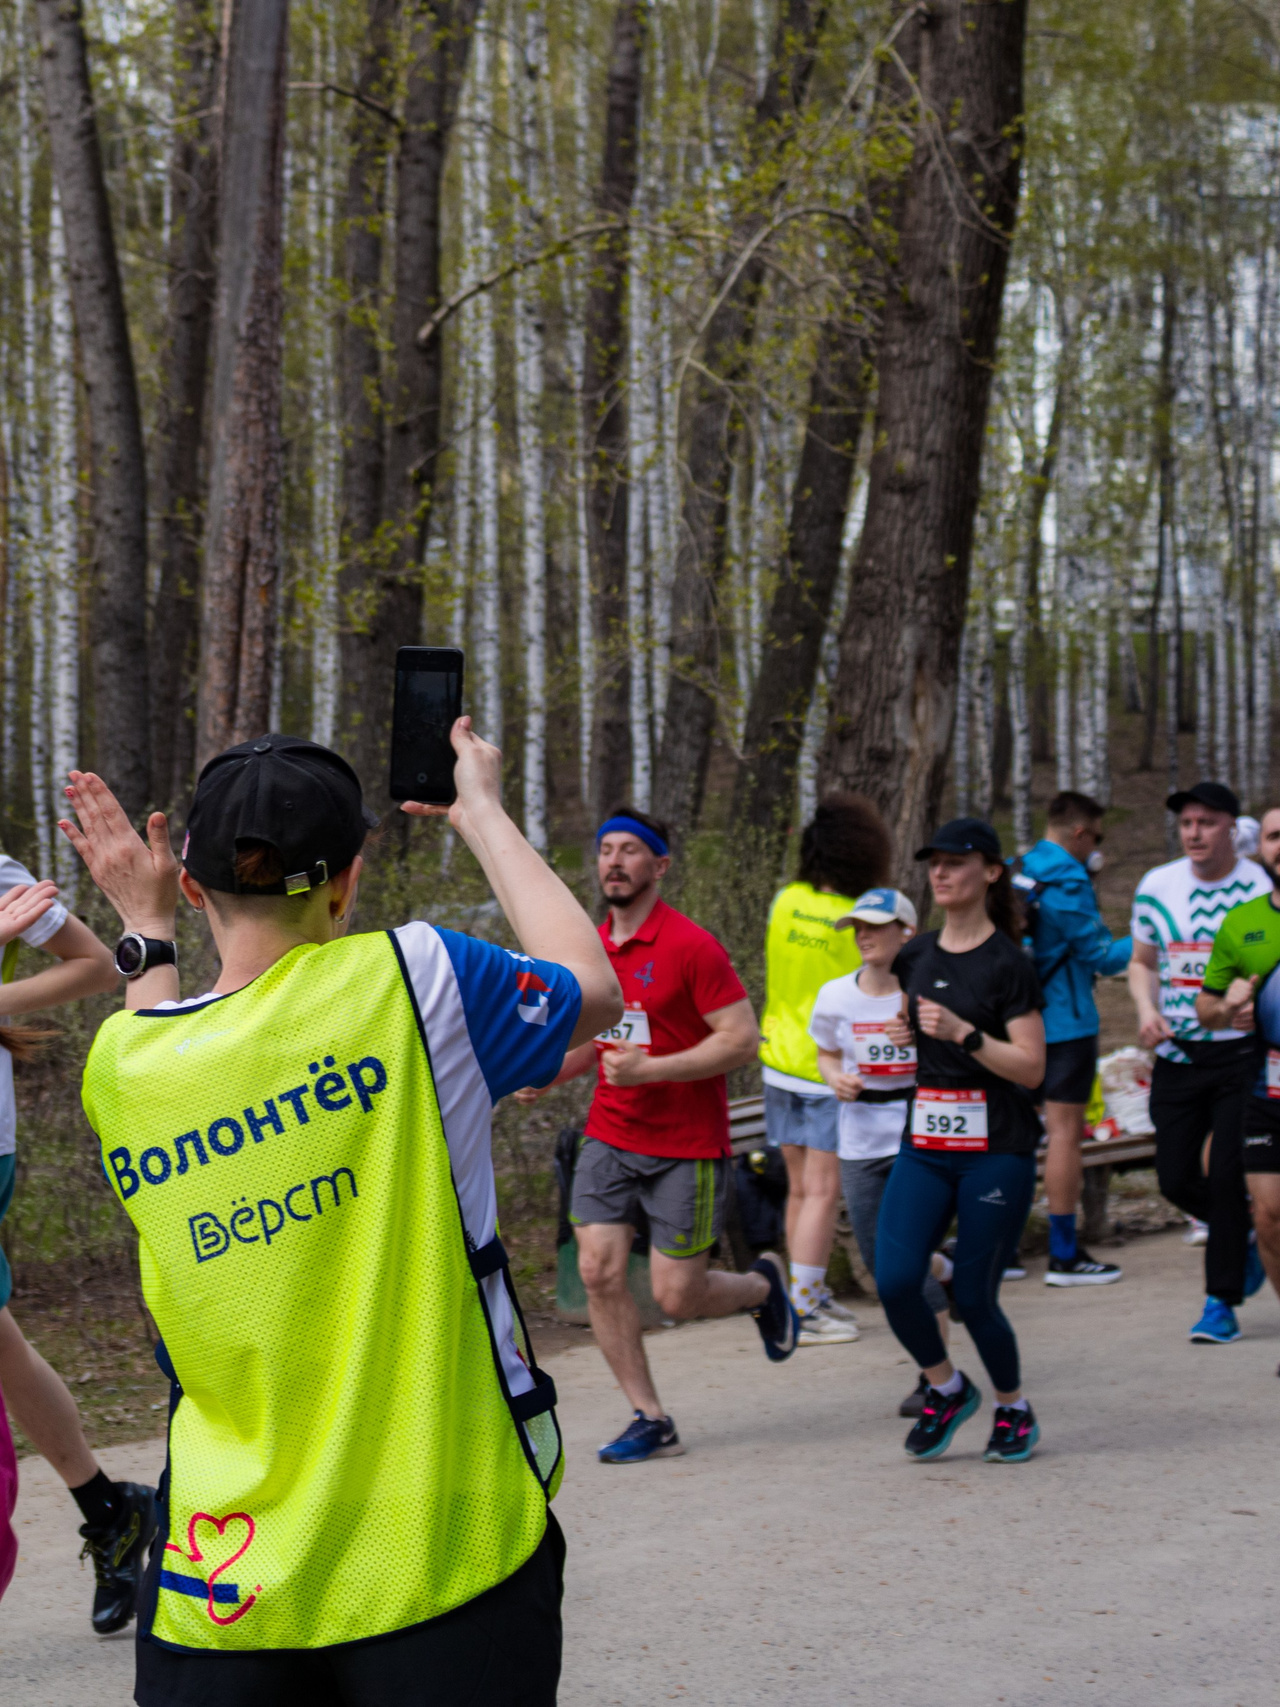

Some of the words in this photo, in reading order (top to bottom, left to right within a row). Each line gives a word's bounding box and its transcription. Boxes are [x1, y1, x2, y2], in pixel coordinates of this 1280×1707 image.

[869, 1045, 910, 1061] 995
[108, 1054, 388, 1200] Волонтёр
[926, 1114, 968, 1134] 592
